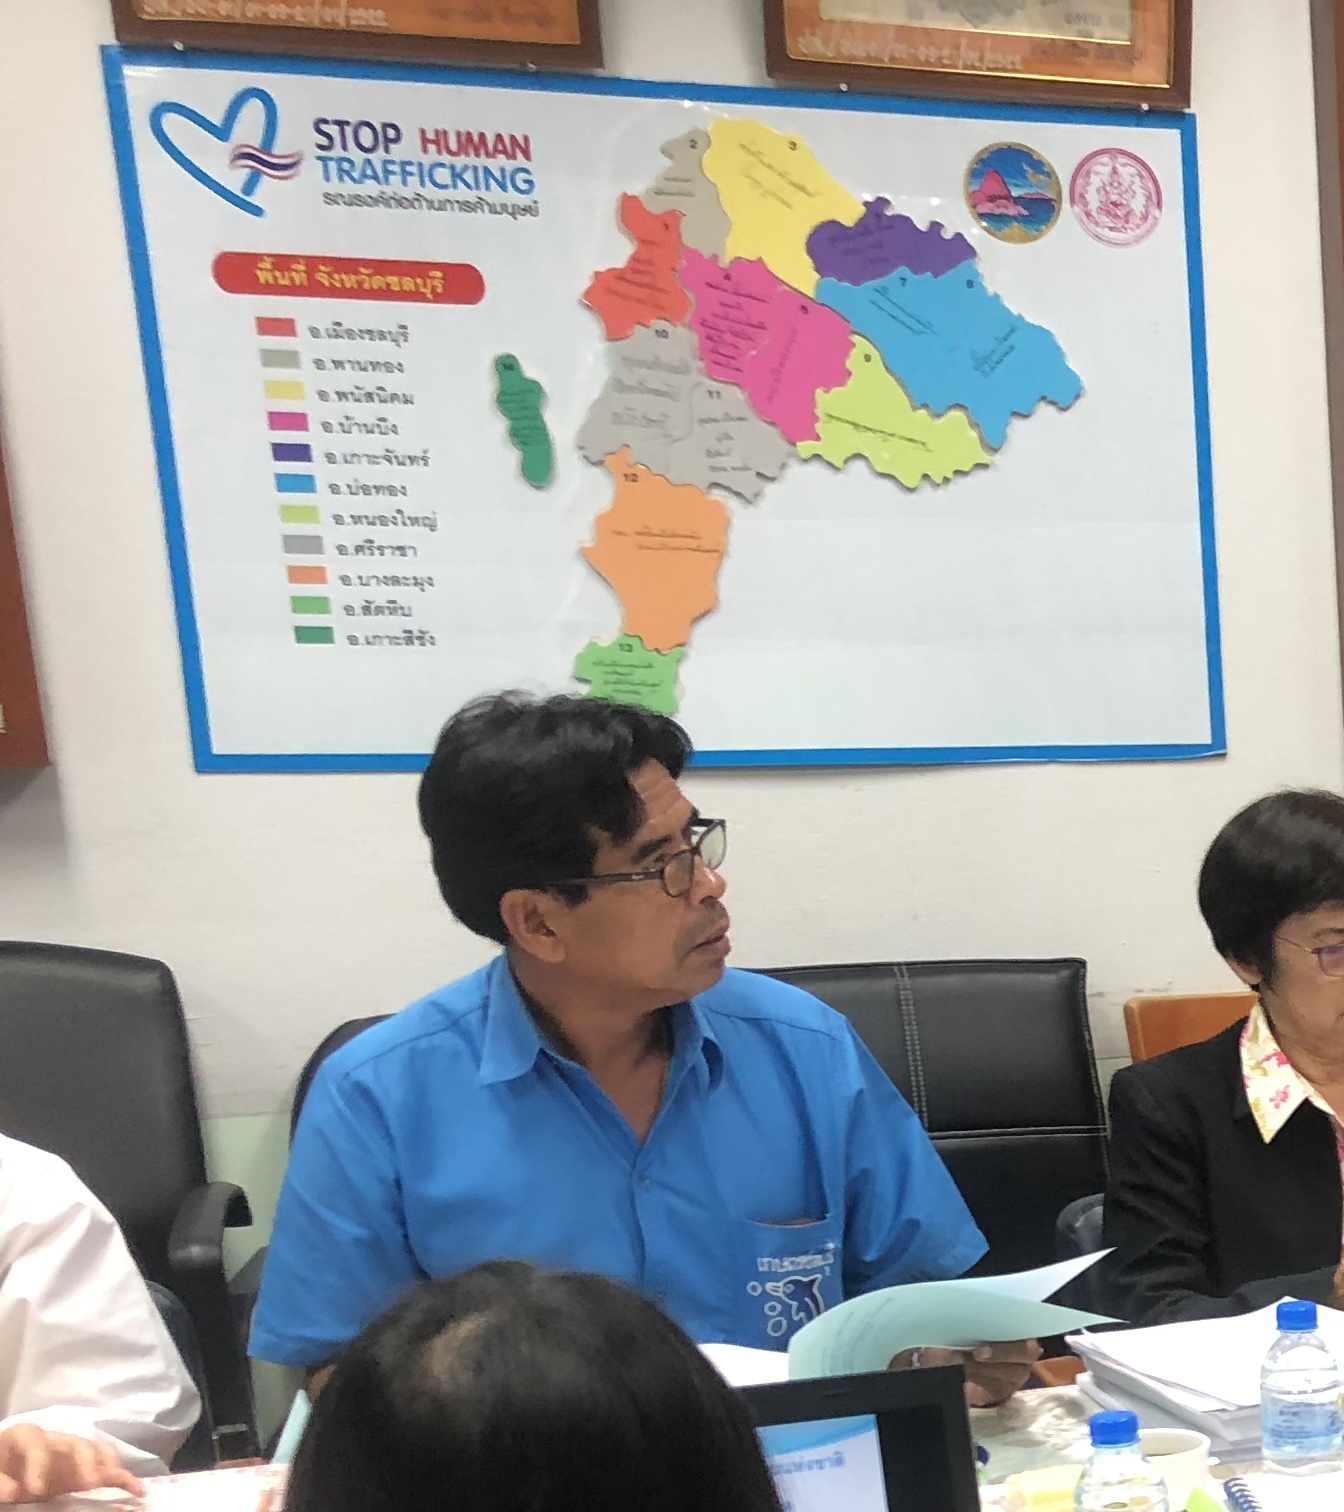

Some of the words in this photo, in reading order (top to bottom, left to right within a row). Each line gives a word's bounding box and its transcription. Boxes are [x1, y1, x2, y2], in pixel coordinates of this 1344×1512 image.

[312, 118, 401, 155] STOP
[419, 127, 530, 162] HUMAN
[317, 155, 536, 196] TRAFFICKING
[254, 256, 309, 288] พื้นที่
[317, 262, 446, 301] จังหวัดชลบุรี
